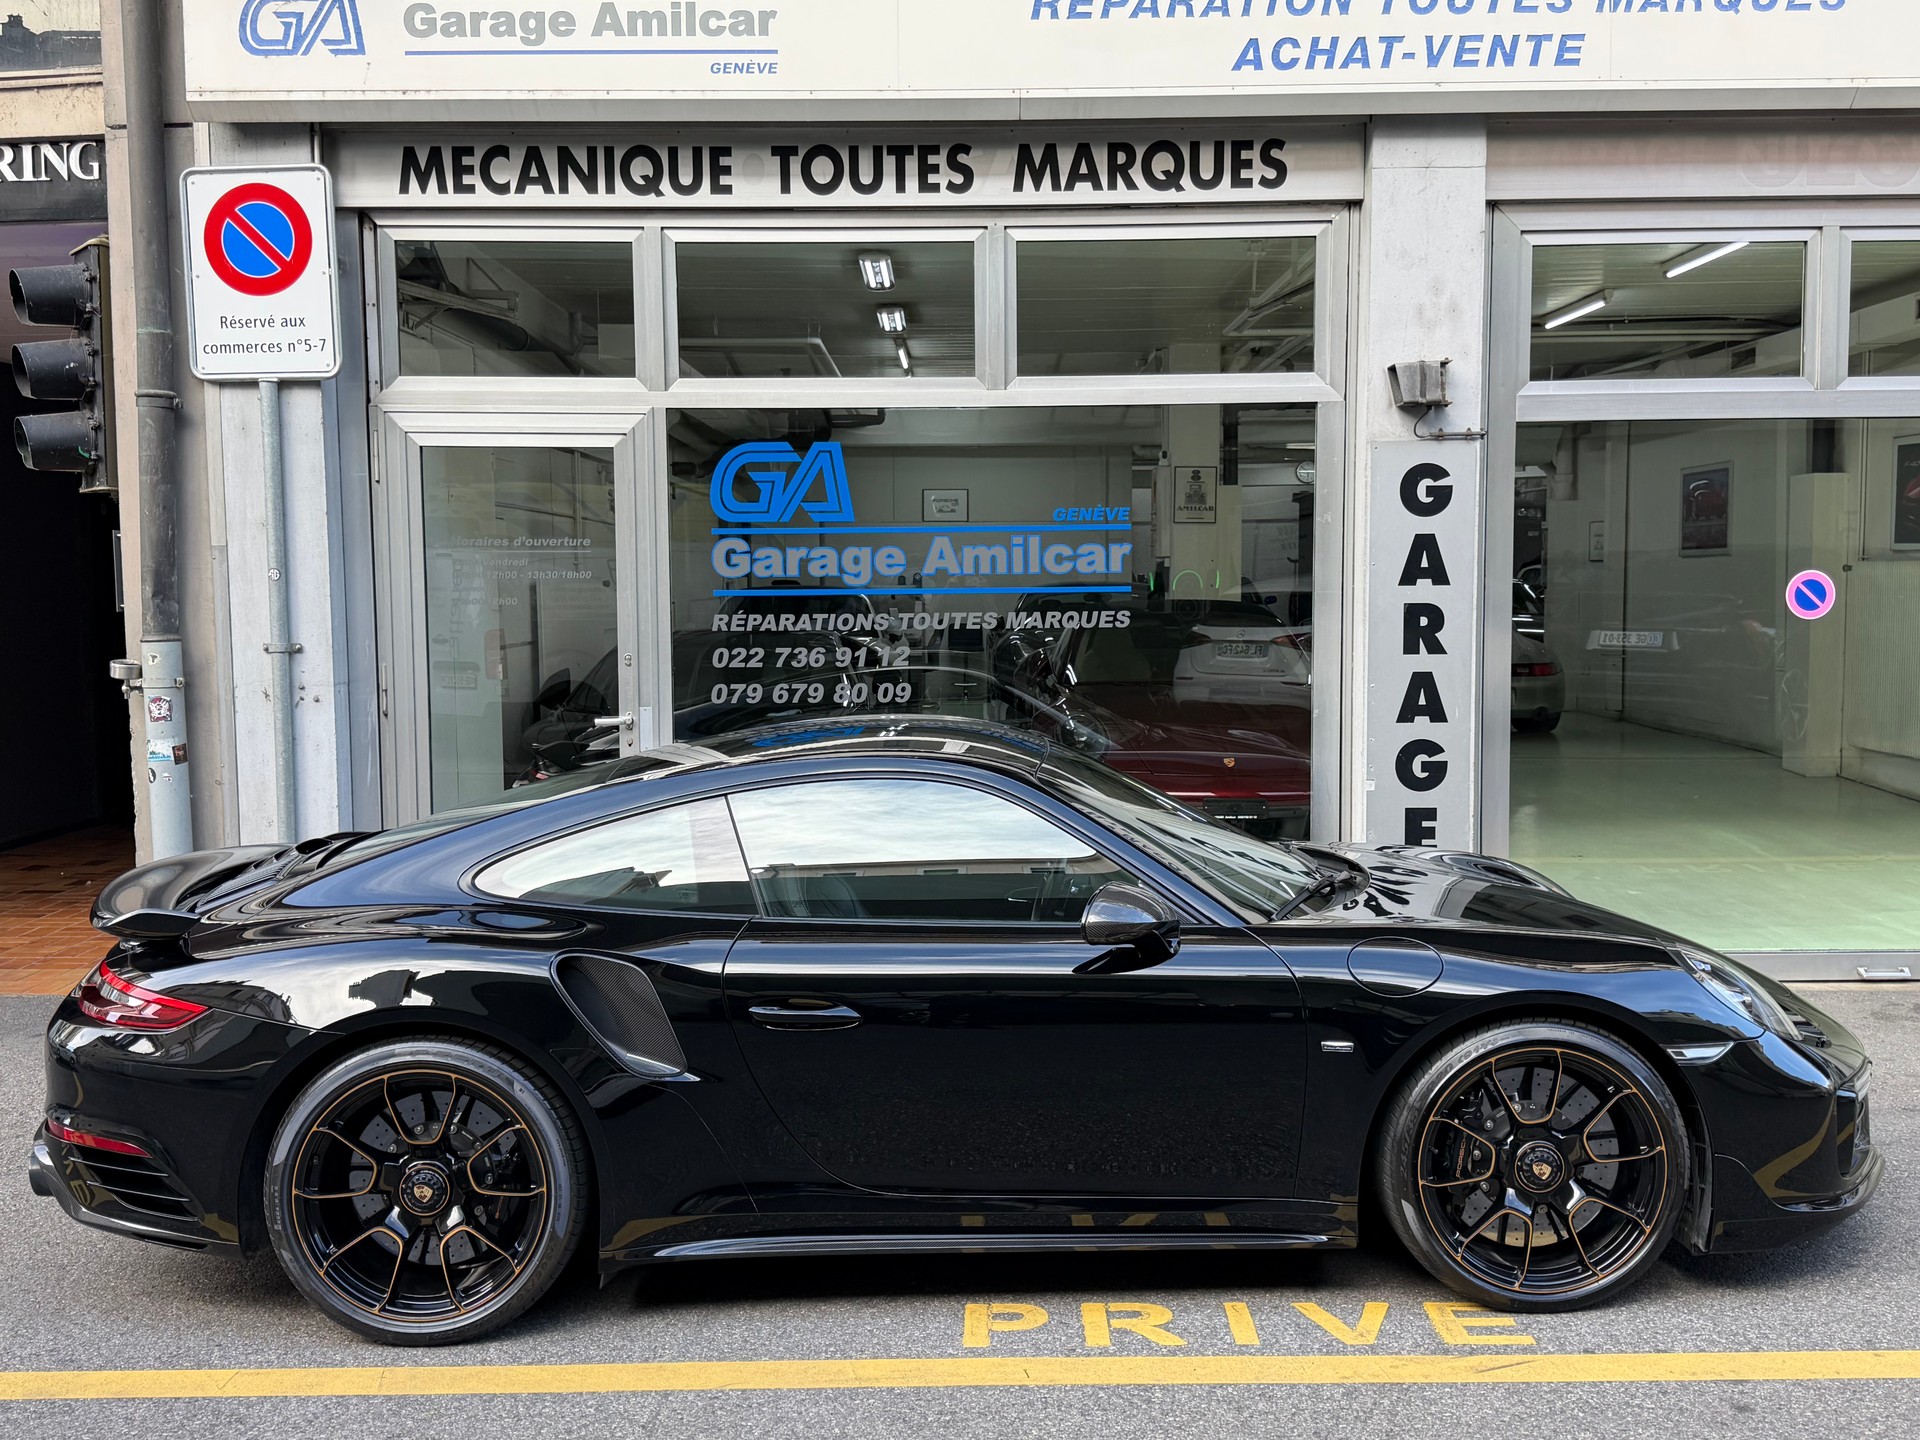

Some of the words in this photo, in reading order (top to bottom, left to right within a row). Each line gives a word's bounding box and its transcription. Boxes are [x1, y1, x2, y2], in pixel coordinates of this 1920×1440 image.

[402, 2, 577, 47] Garage
[590, 1, 778, 38] Amilcar
[709, 59, 778, 75] GENÈVE
[1231, 33, 1586, 71] ACHAT-VENTE
[399, 144, 733, 197] MECANIQUE
[771, 143, 975, 195] TOUTES
[1012, 137, 1288, 193] MARQUES
[219, 314, 275, 329] Réservé
[280, 316, 306, 328] aux
[202, 342, 283, 355] commerces
[710, 441, 855, 522] GA
[1052, 503, 1130, 522] GENÈVE
[711, 536, 907, 587] Garage
[921, 534, 1132, 577] Amilcar
[711, 608, 890, 632] RÉPARATIONS
[898, 611, 998, 631] TOUTES
[1005, 609, 1132, 630] MARQUES
[711, 647, 764, 668] 022
[774, 647, 826, 668] 736
[835, 647, 867, 668] 91
[877, 646, 912, 667] 12
[1395, 462, 1453, 846] GARAGE
[710, 683, 763, 704] 079
[772, 683, 825, 704] 679
[833, 682, 868, 704] 80
[877, 682, 912, 704] 09
[1455, 1134, 1467, 1178] PORSCH
[961, 1301, 1537, 1349] PRIVE
